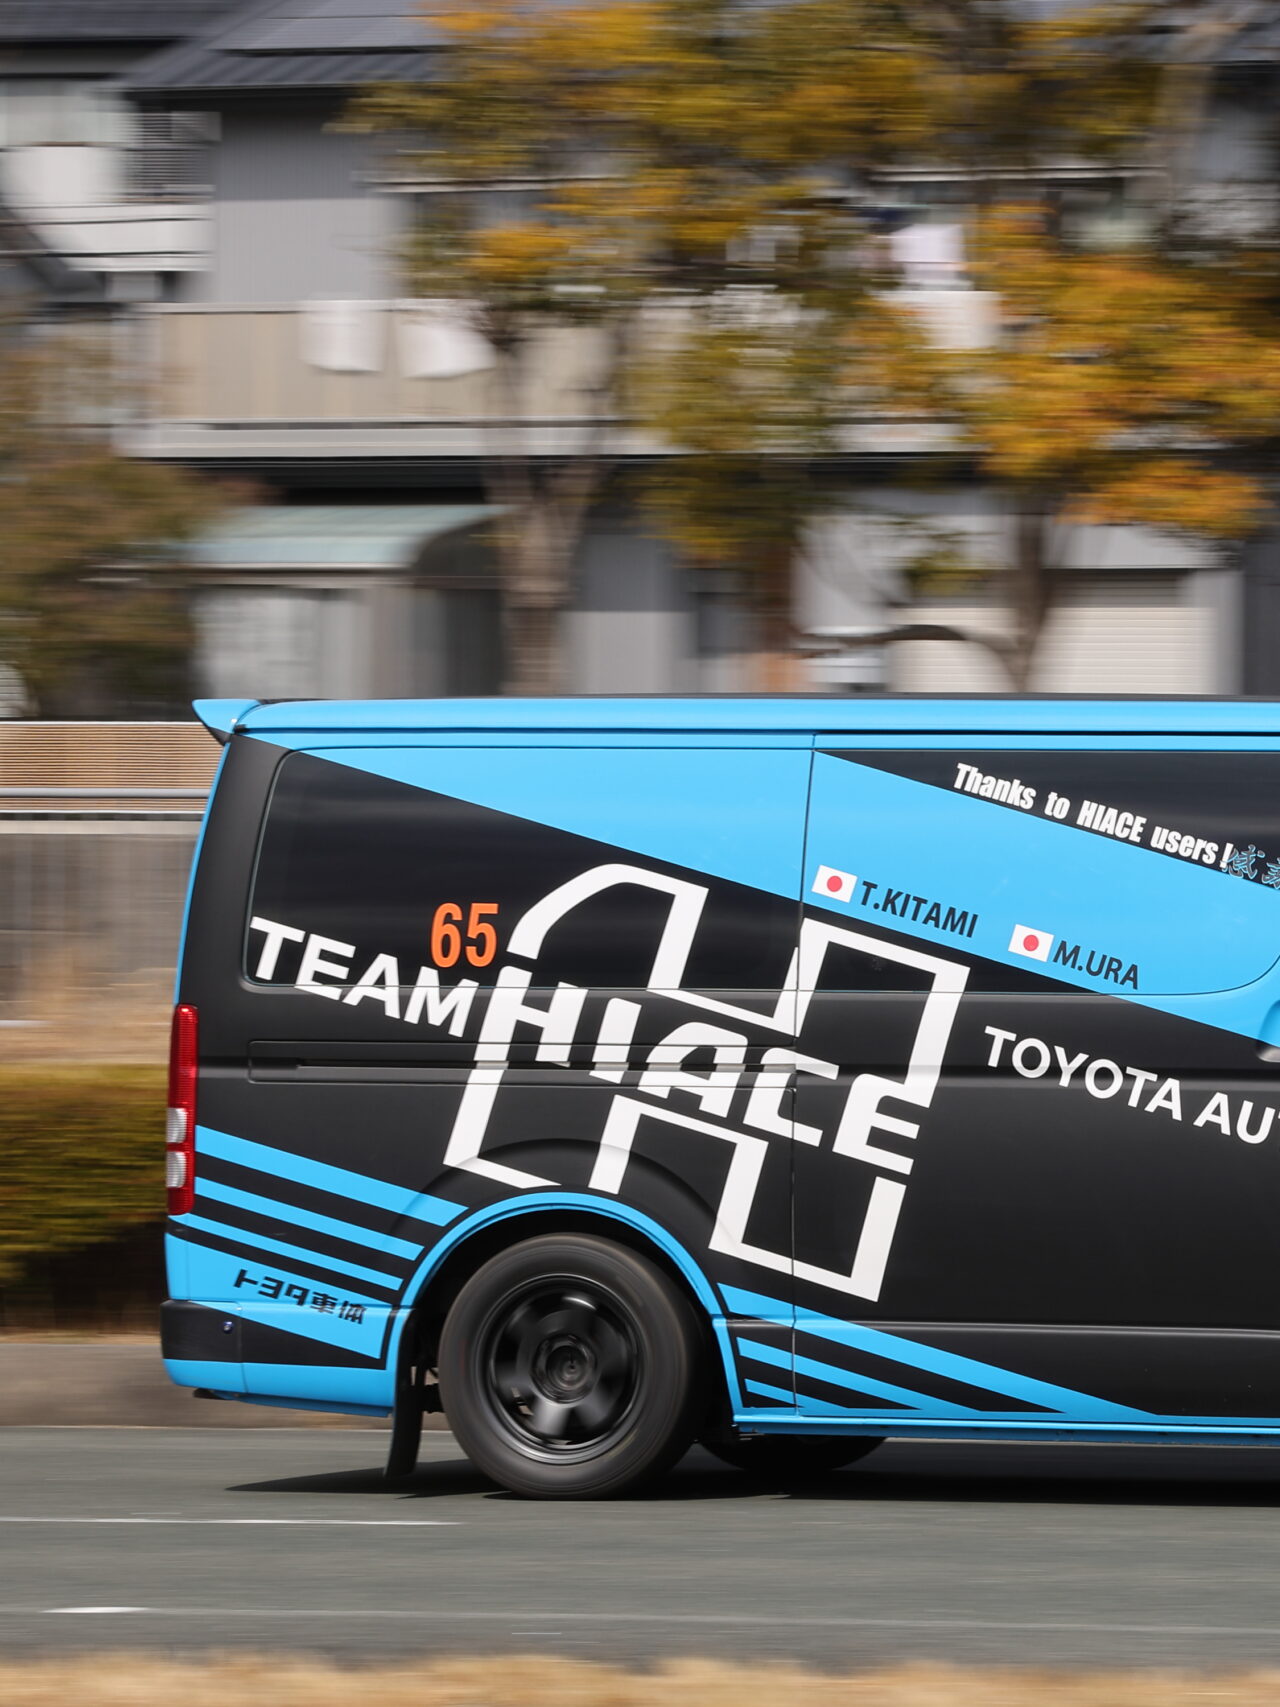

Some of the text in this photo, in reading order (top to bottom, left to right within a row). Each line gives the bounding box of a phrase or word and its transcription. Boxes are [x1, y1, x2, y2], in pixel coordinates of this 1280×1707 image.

[954, 762, 1036, 810] Thanks
[1044, 790, 1071, 820] to
[1076, 799, 1147, 843] HIACE
[430, 902, 499, 968] 65
[860, 880, 978, 939] T.KITAMI
[1053, 940, 1139, 990] M.URA
[250, 917, 921, 1175] TEAM HIACE
[984, 1025, 1184, 1121] TOYOTA
[233, 1268, 368, 1325] トヨタ車体
